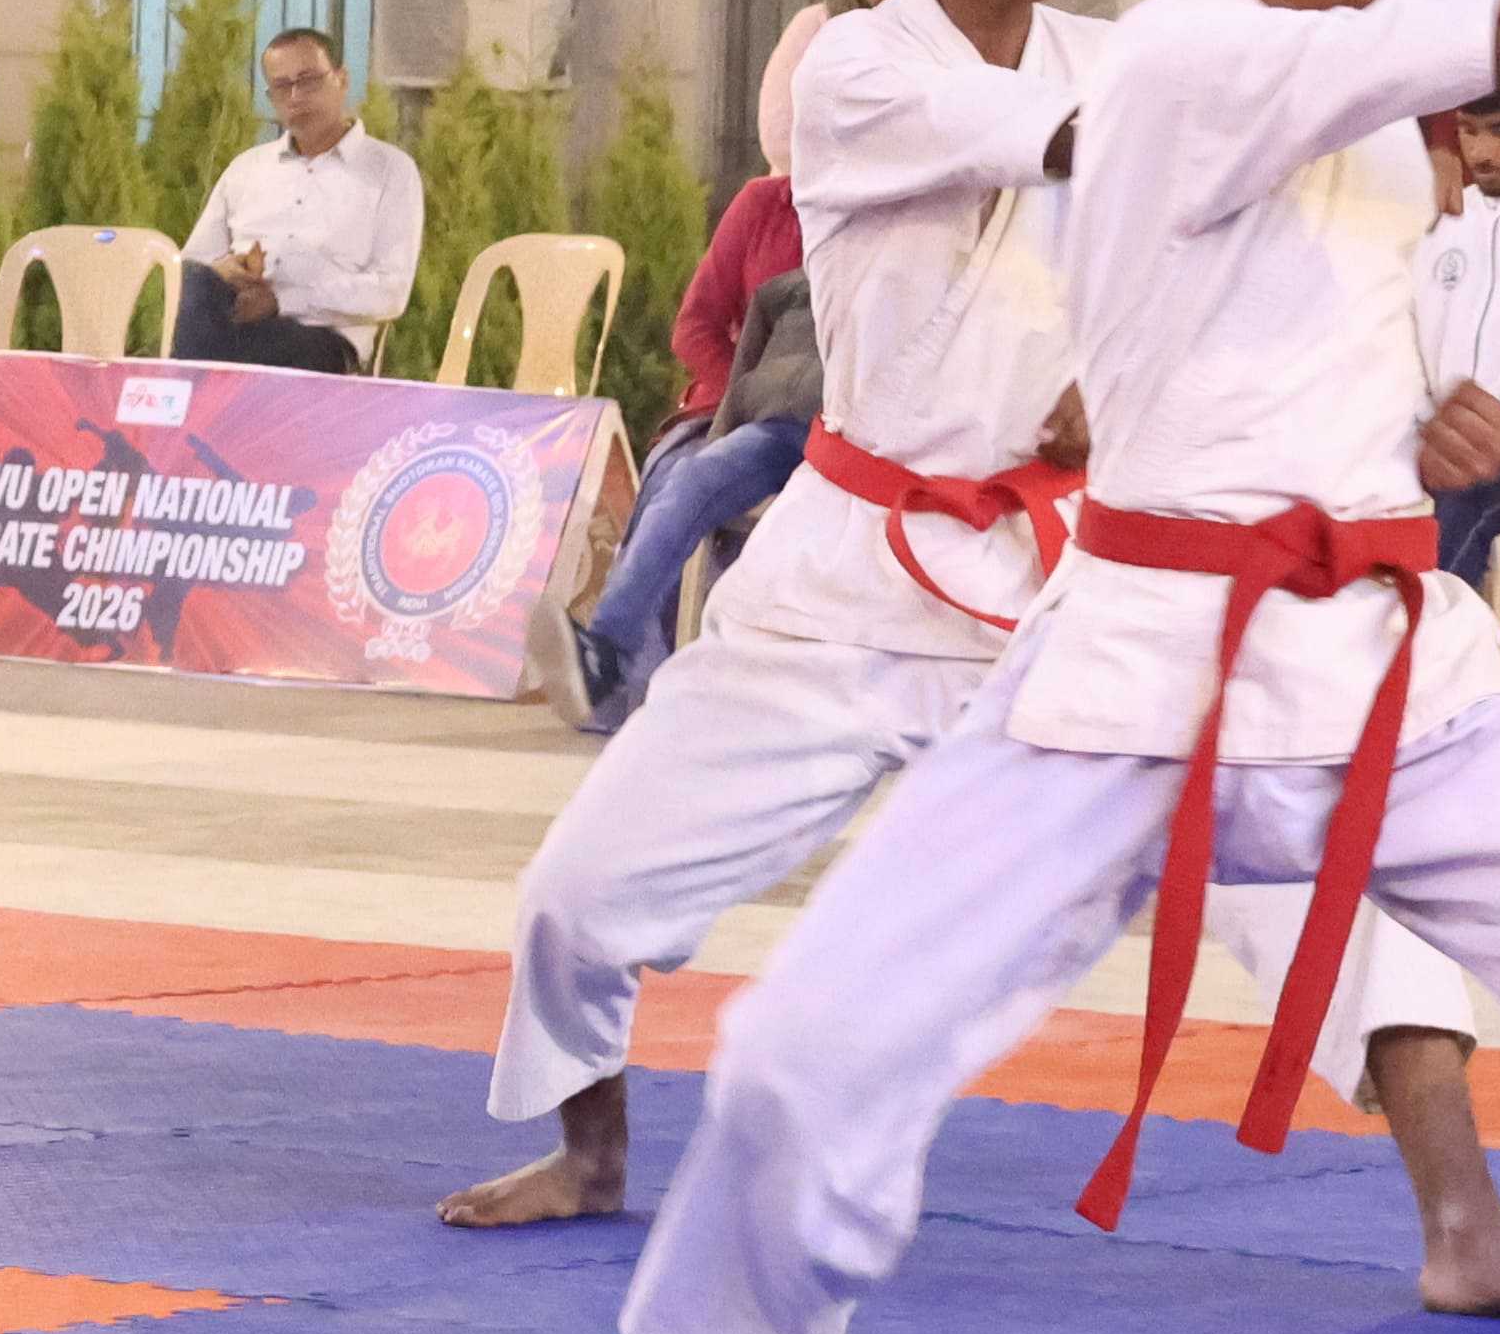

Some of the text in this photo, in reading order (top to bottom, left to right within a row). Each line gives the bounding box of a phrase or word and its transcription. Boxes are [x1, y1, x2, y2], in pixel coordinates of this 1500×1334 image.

[38, 466, 130, 518] OPEN
[132, 473, 294, 531] NATIONAL
[62, 524, 306, 587] CHIMPIONSHIP
[56, 583, 145, 633] 2026
